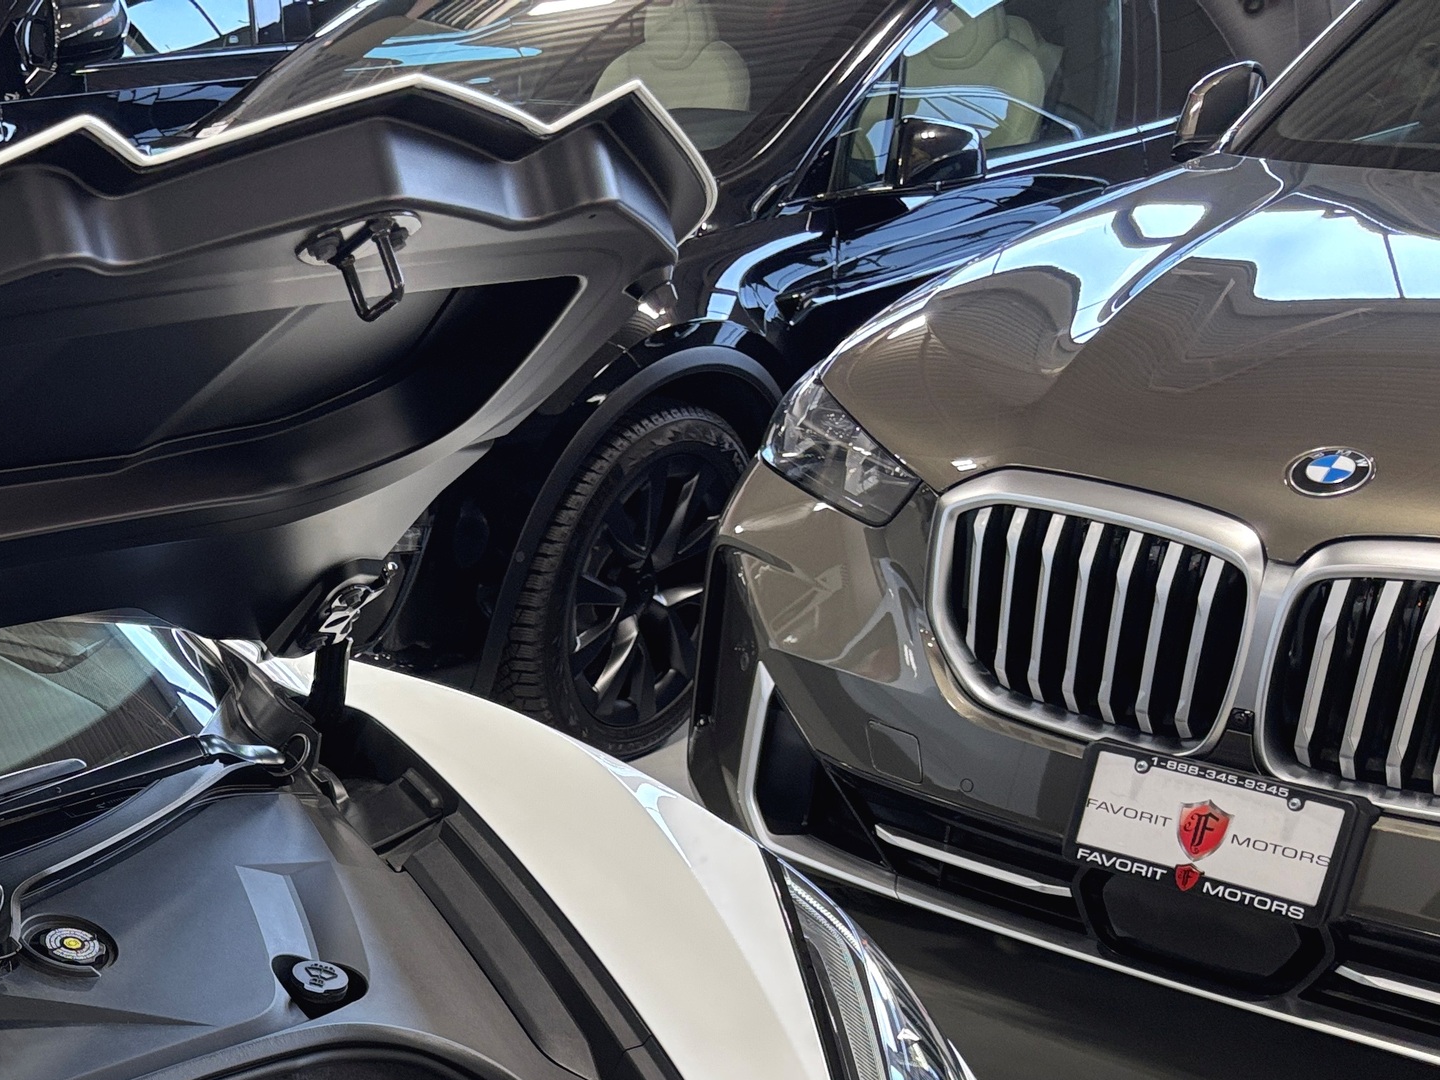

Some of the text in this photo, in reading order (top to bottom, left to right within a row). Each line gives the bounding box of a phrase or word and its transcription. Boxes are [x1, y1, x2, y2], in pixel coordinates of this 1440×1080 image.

[1151, 757, 1290, 798] 1-888-345-9345
[1086, 798, 1173, 827] FAVORIT
[1231, 834, 1331, 867] MOTORS
[1076, 848, 1167, 881] FAVORIT
[1202, 881, 1305, 920] MOTORS
